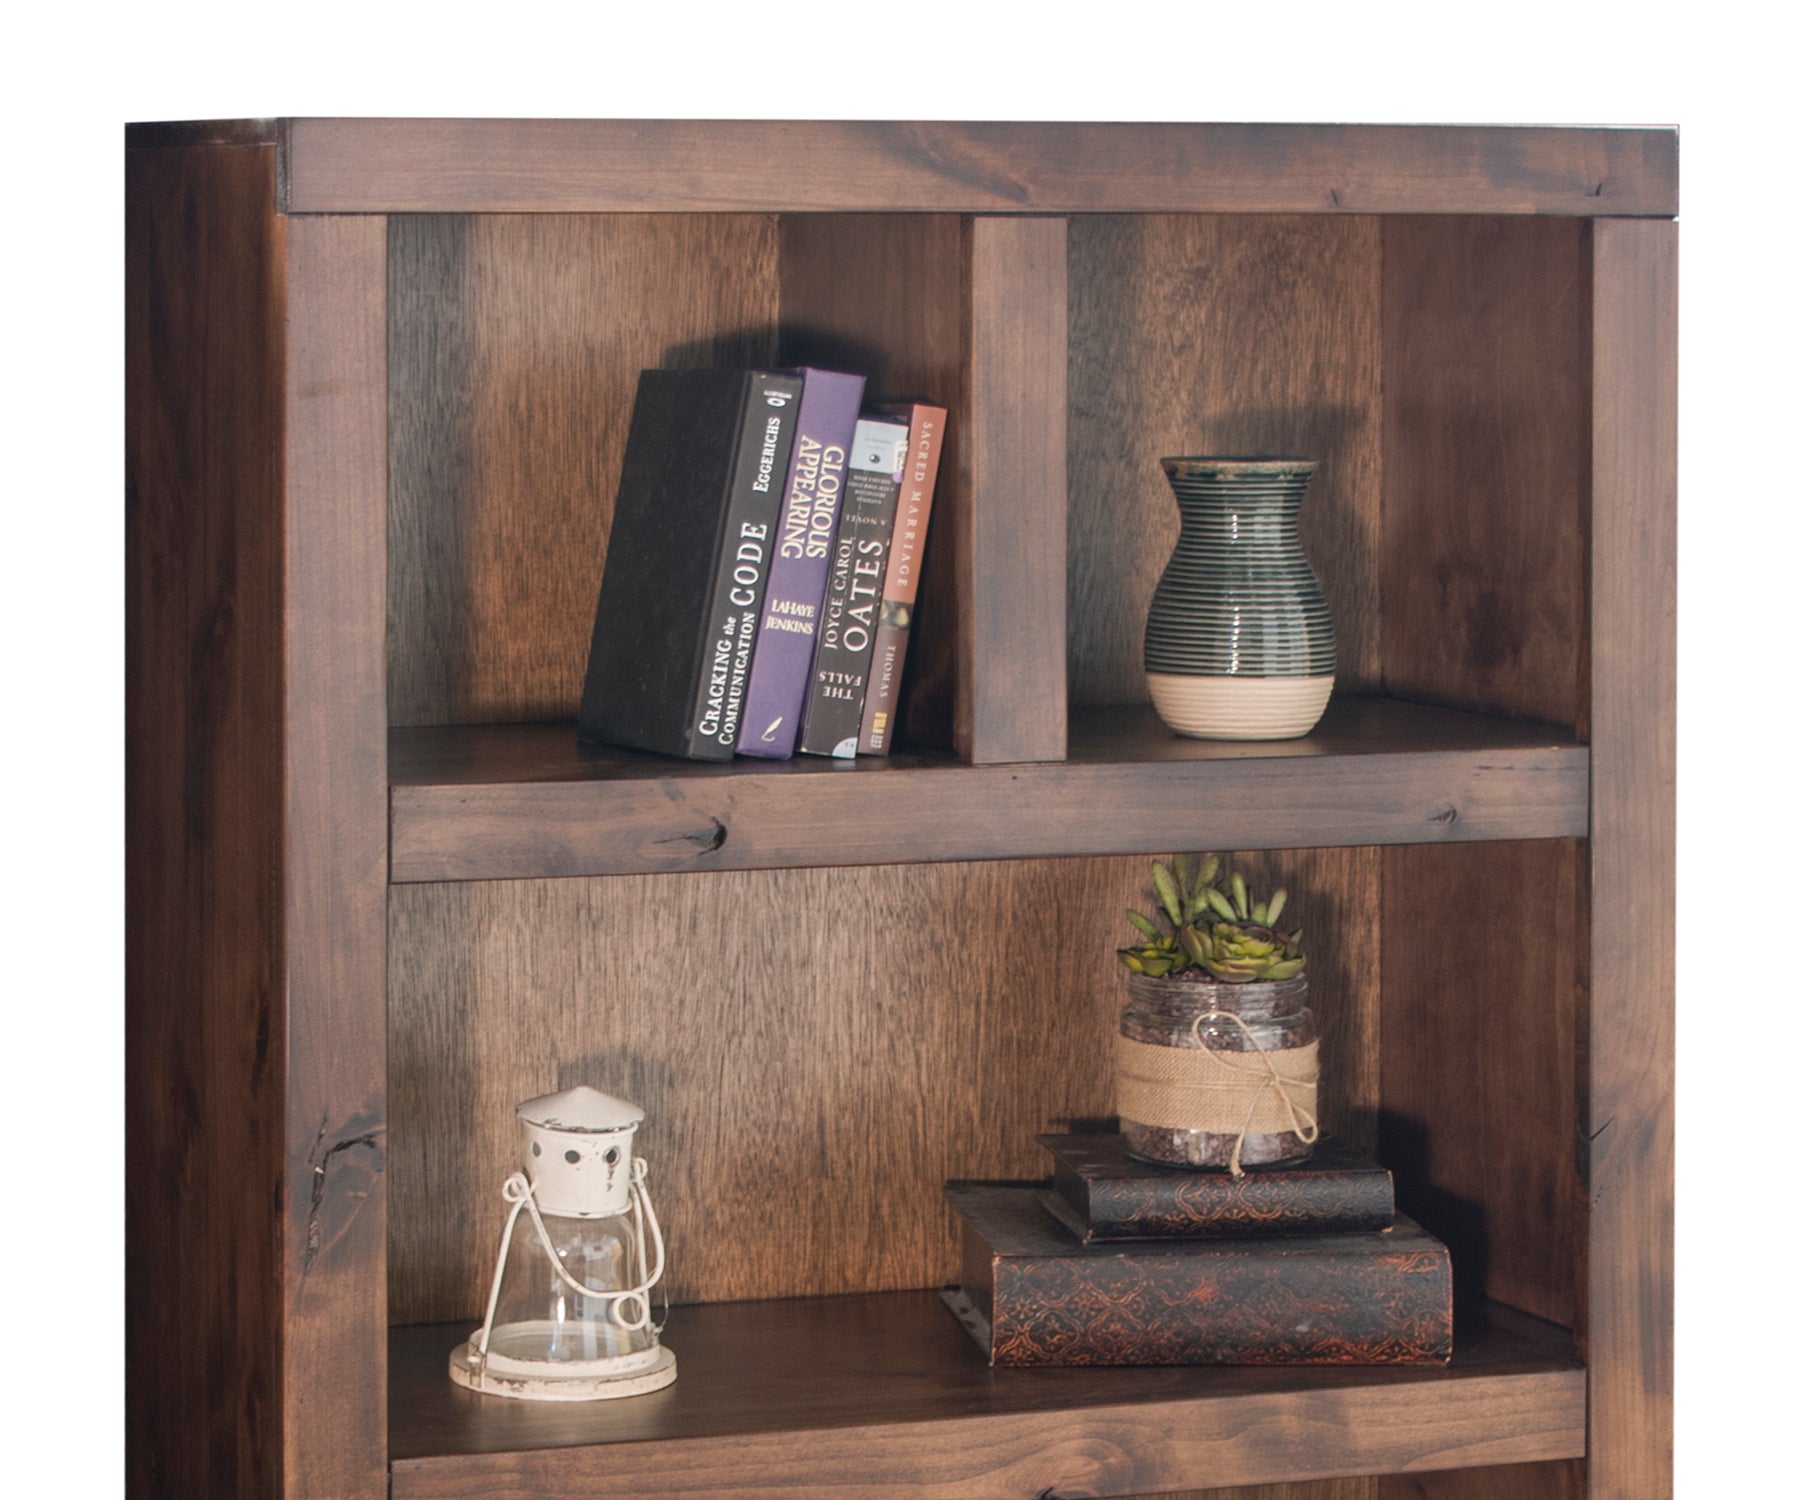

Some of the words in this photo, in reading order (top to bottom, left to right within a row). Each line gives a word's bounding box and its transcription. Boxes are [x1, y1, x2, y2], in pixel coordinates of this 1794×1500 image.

[752, 417, 780, 493] EGGERICHS
[914, 421, 933, 482] SACRED
[781, 435, 822, 559] APPEARING
[806, 446, 845, 559] GLORIOUS
[897, 490, 922, 586] MARRIAGE
[730, 522, 767, 607] CODE
[824, 598, 843, 649] JOYCE
[834, 537, 853, 591] CAROL
[843, 540, 883, 652] OATES
[765, 616, 814, 635] JENKINS
[699, 639, 732, 736] CRACKING
[723, 616, 737, 636] the
[718, 612, 756, 745] COMMUNICATION
[818, 670, 862, 687] FALLS
[823, 686, 854, 700] THE
[880, 645, 896, 698] THOMAS
